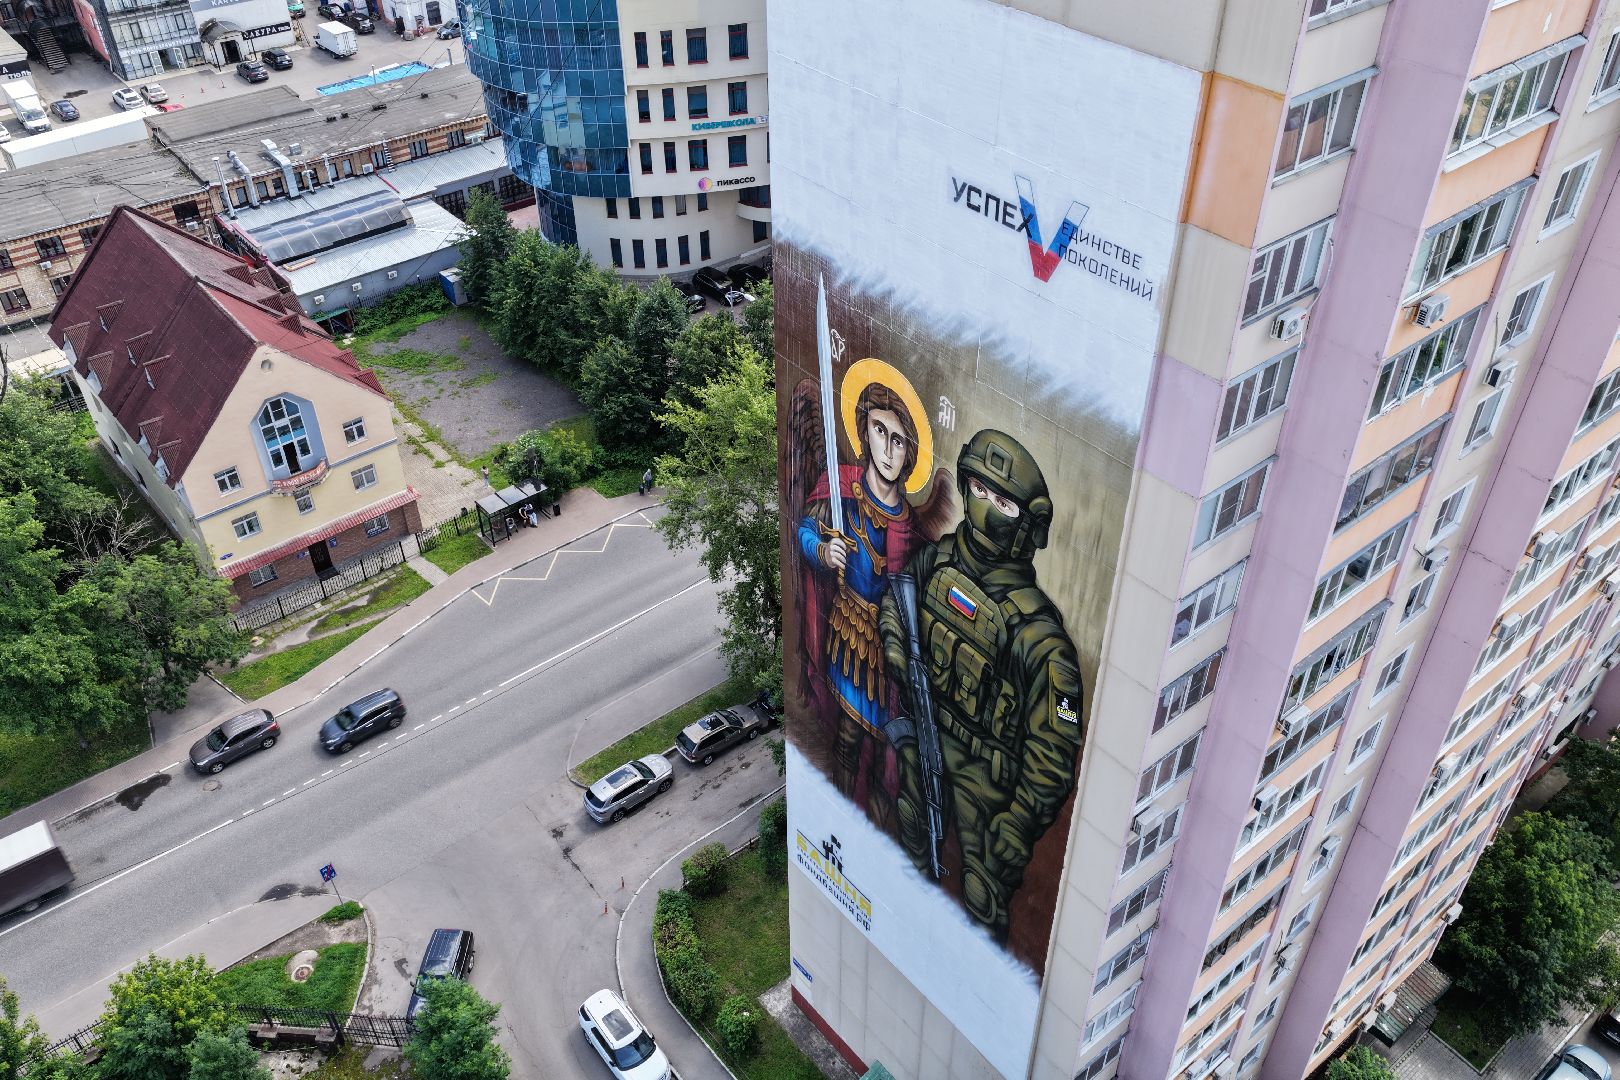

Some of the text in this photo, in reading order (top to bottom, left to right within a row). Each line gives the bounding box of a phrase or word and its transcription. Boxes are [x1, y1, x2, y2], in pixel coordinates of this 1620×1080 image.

[691, 117, 756, 131] КИБЕРШКОЛА
[951, 176, 1035, 239] УСПЕХ
[1058, 243, 1154, 301] ПОКОЛЕНИЙ
[1061, 220, 1143, 271] ЕДИНСТВЕ
[796, 832, 872, 917] БАШНЯ
